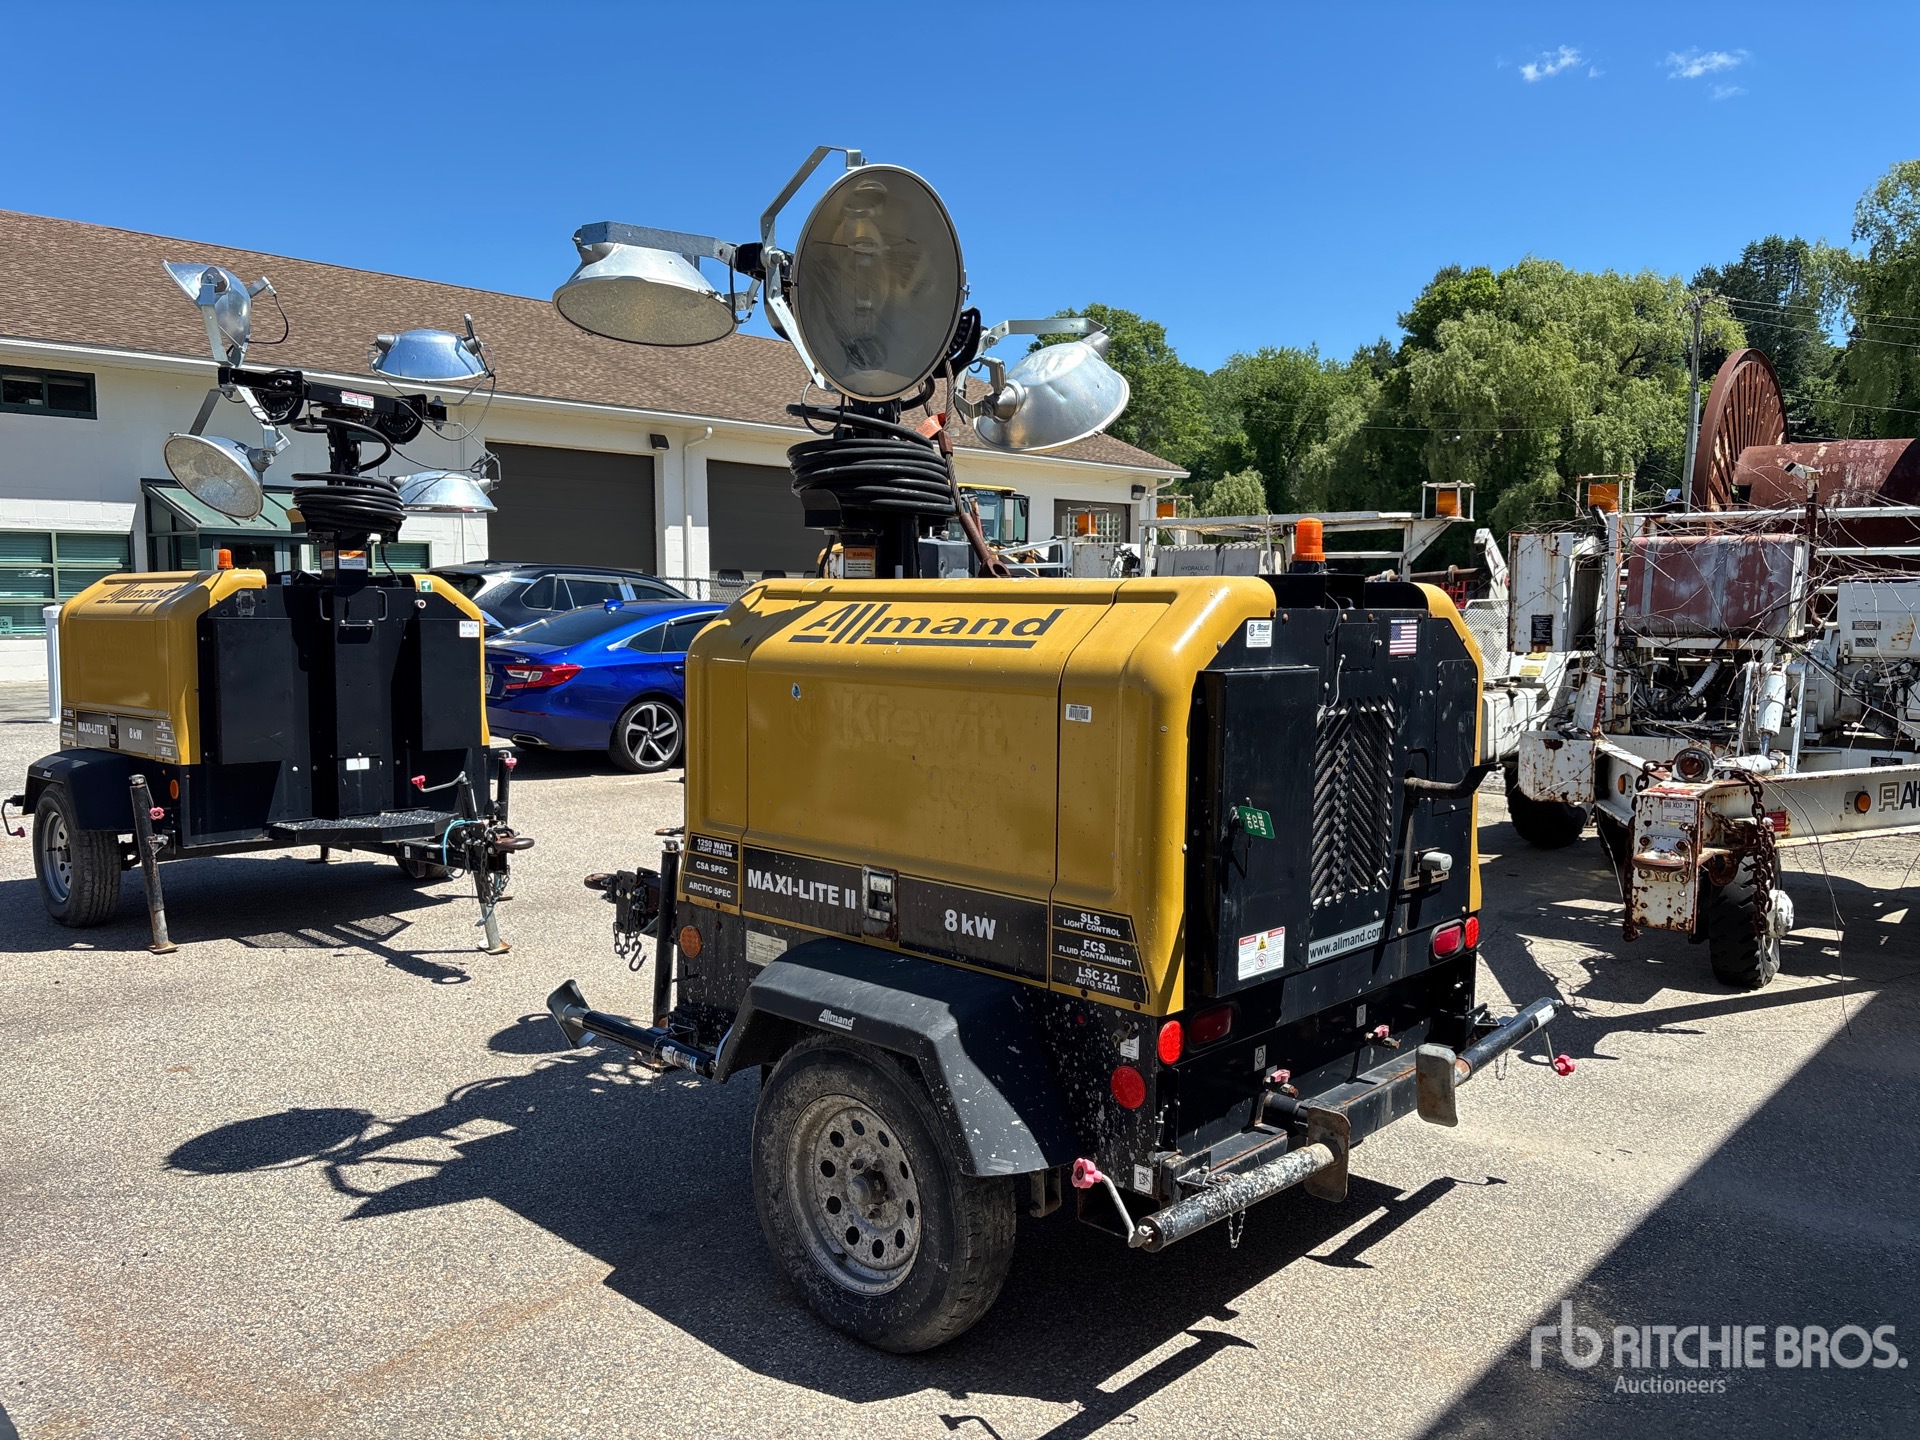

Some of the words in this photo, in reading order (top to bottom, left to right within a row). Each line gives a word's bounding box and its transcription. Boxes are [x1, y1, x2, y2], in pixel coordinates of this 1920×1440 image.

[800, 603, 1066, 644] Allmand
[77, 721, 104, 735] MAXI-LITE
[1245, 812, 1253, 829] OK
[1251, 814, 1259, 829] TO
[1256, 811, 1267, 835] USE
[697, 839, 713, 848] 1250
[714, 842, 733, 851] WATT
[697, 845, 712, 854] LIGHT
[712, 848, 733, 858] SYSTEM
[696, 860, 710, 872] CSA
[711, 865, 728, 875] SPEC
[688, 881, 713, 894] ARCTIC
[714, 886, 732, 899] SPEC
[747, 868, 840, 907] MAXI-LITE
[844, 888, 856, 910] II
[1063, 918, 1084, 930] LIGHT
[1086, 924, 1121, 937] CONTROL
[1080, 912, 1101, 926] SLS
[1083, 939, 1106, 953] FCS
[1309, 925, 1384, 959] www.allmand.com
[1058, 945, 1079, 955] FLUID
[1080, 949, 1132, 967] CONTAINMENT
[1078, 966, 1100, 981] LSC
[1102, 972, 1118, 985] 2.1
[1075, 976, 1096, 987] AUTO
[1097, 982, 1121, 993] START
[819, 1008, 854, 1028] Allmand
